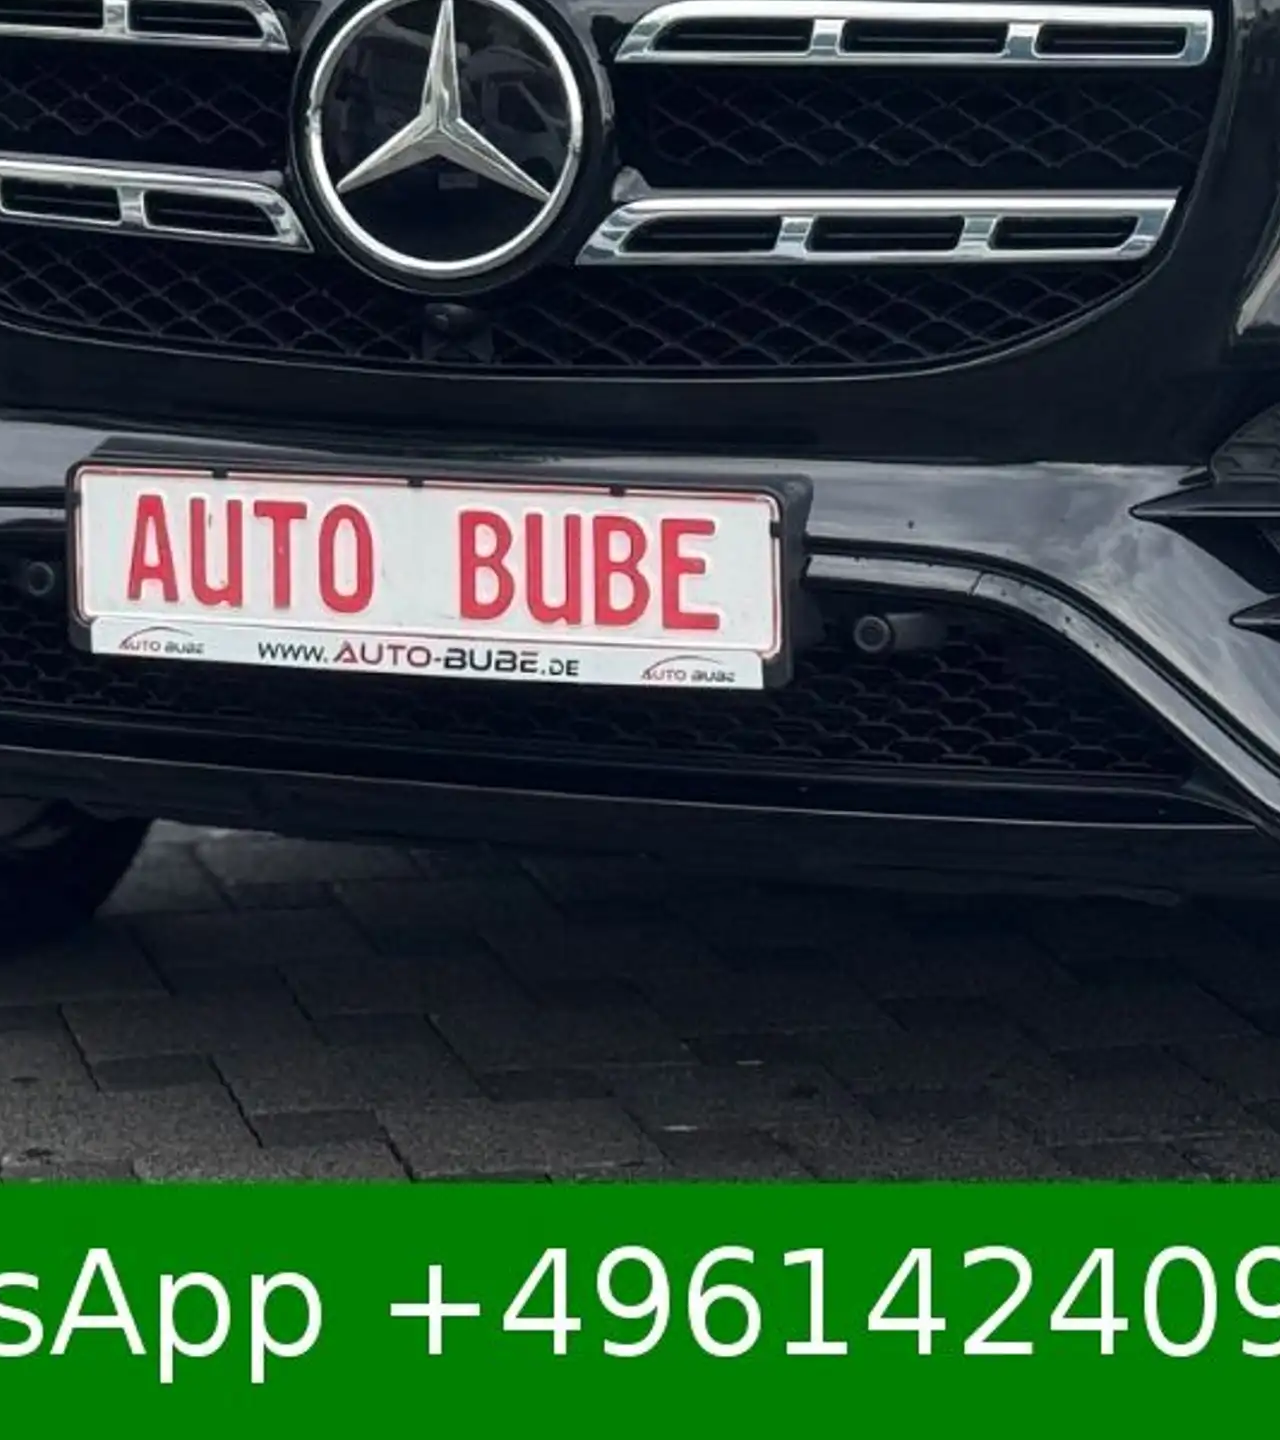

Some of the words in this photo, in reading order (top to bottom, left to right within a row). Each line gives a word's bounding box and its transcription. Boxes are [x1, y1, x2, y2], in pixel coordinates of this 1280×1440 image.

[127, 495, 374, 614] AUTO
[458, 510, 720, 631] BUBE
[120, 638, 161, 653] AUTO
[641, 667, 687, 681] AUTO
